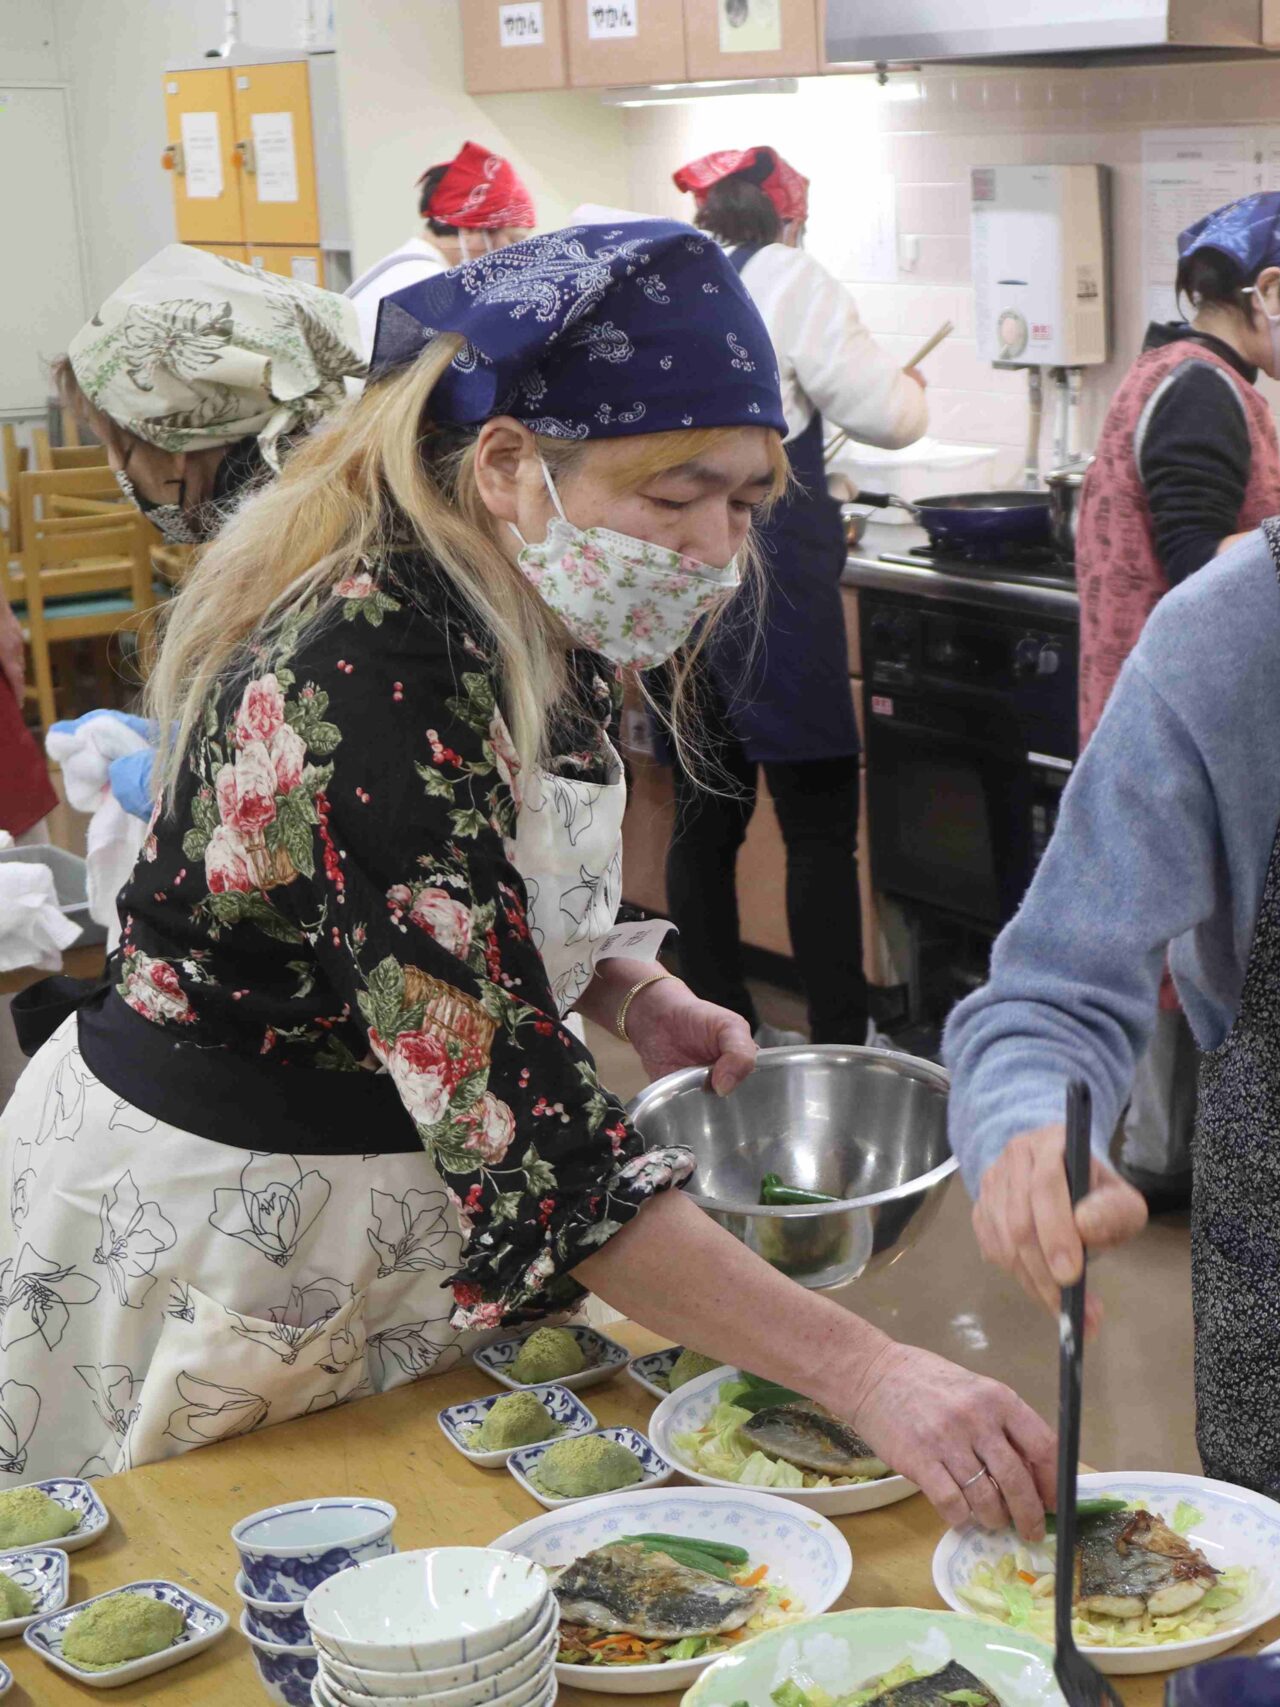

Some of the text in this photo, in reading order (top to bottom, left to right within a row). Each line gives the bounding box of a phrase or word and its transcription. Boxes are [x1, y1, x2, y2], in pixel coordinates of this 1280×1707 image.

[504, 13, 539, 36] やかん
[593, 6, 632, 28] やかん
